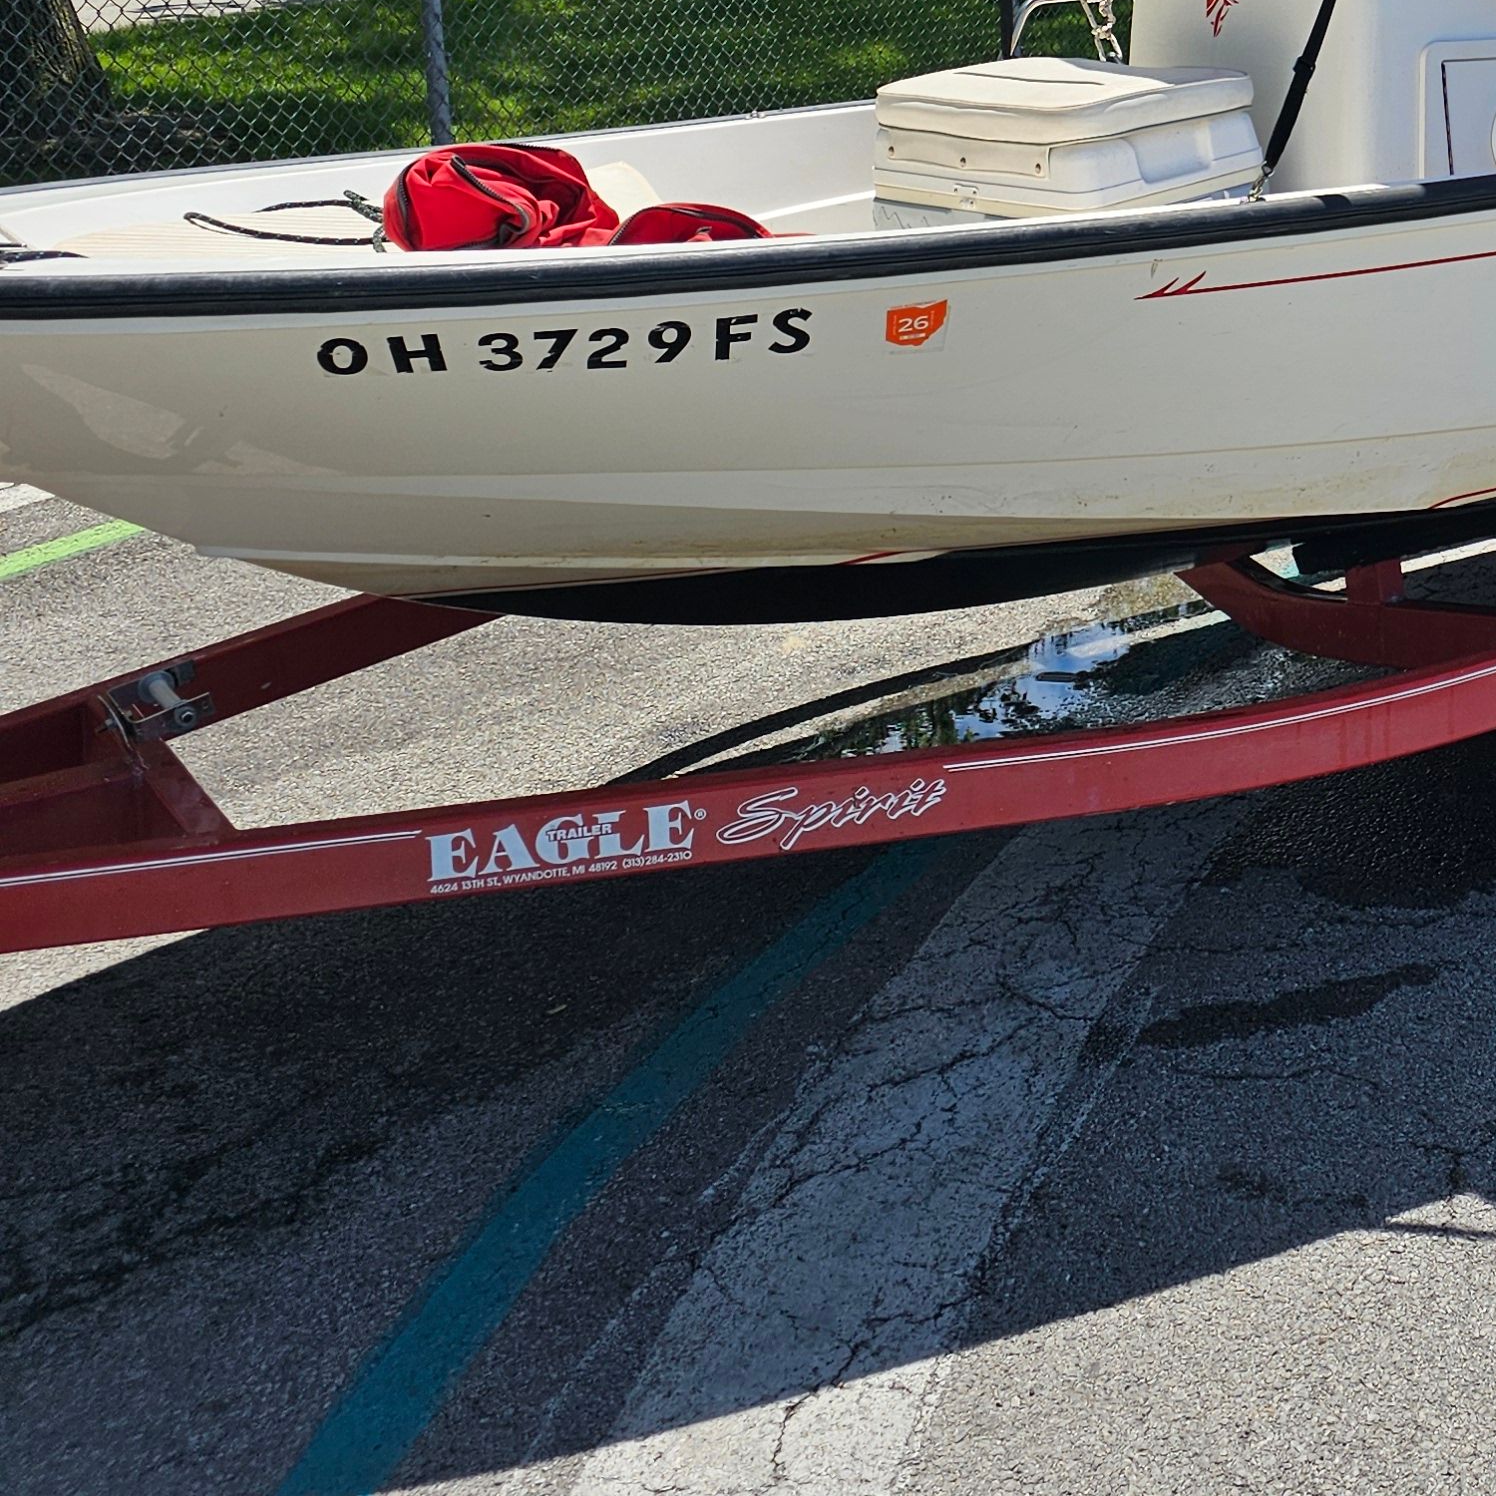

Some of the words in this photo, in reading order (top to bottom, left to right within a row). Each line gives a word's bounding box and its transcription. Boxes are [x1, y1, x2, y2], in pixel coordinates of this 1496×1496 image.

[897, 315, 929, 333] 26
[316, 333, 448, 376] OH
[716, 778, 948, 851] Spirit
[546, 823, 613, 843] TRAILER
[430, 882, 458, 894] 4624
[462, 879, 485, 890] 13TH
[572, 864, 586, 875] MI
[588, 860, 618, 873] 48192
